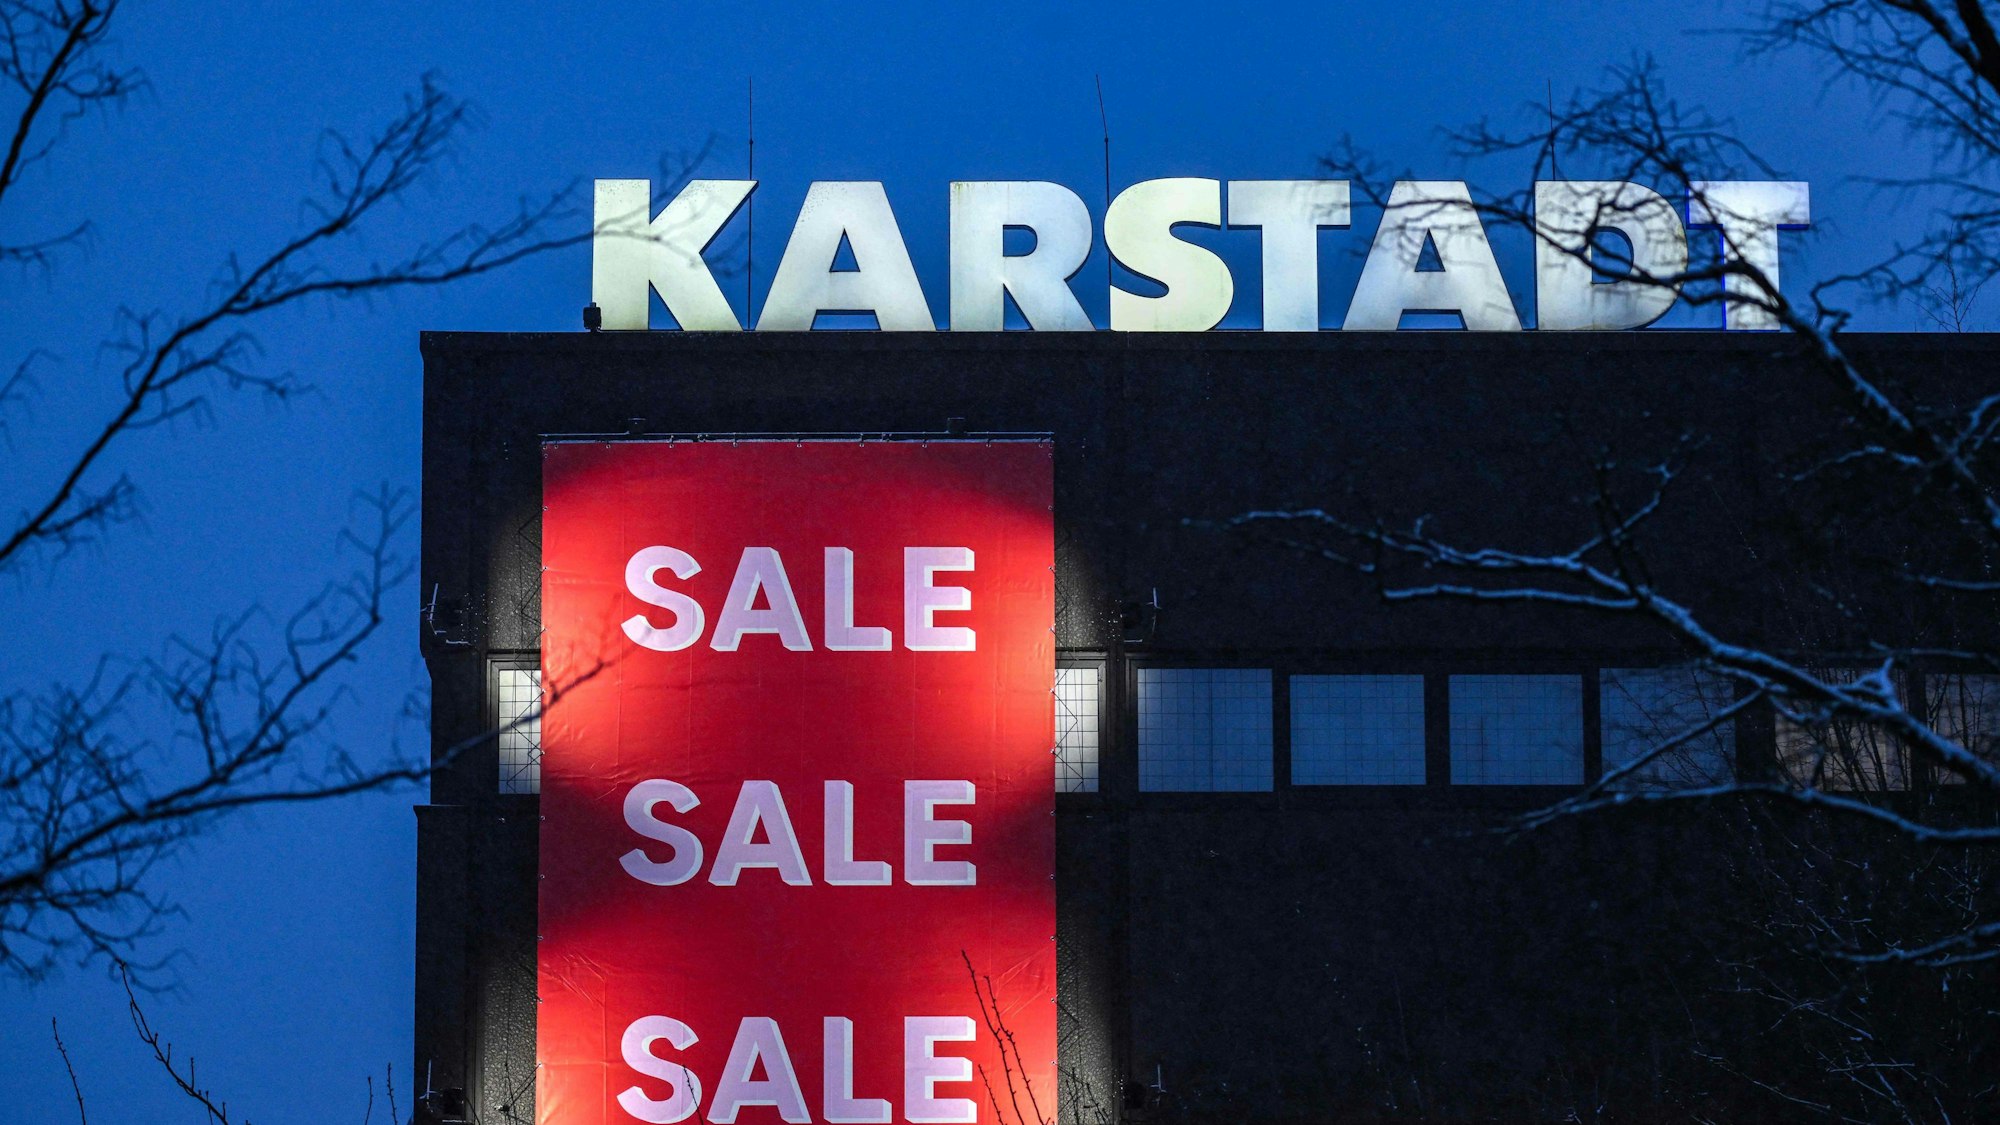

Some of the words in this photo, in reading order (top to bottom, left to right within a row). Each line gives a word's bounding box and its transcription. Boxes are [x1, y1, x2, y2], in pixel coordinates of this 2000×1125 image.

[591, 178, 1810, 332] KARSTADT
[620, 546, 977, 652] SALE
[619, 779, 977, 887] SALE
[617, 1016, 978, 1125] SALE
